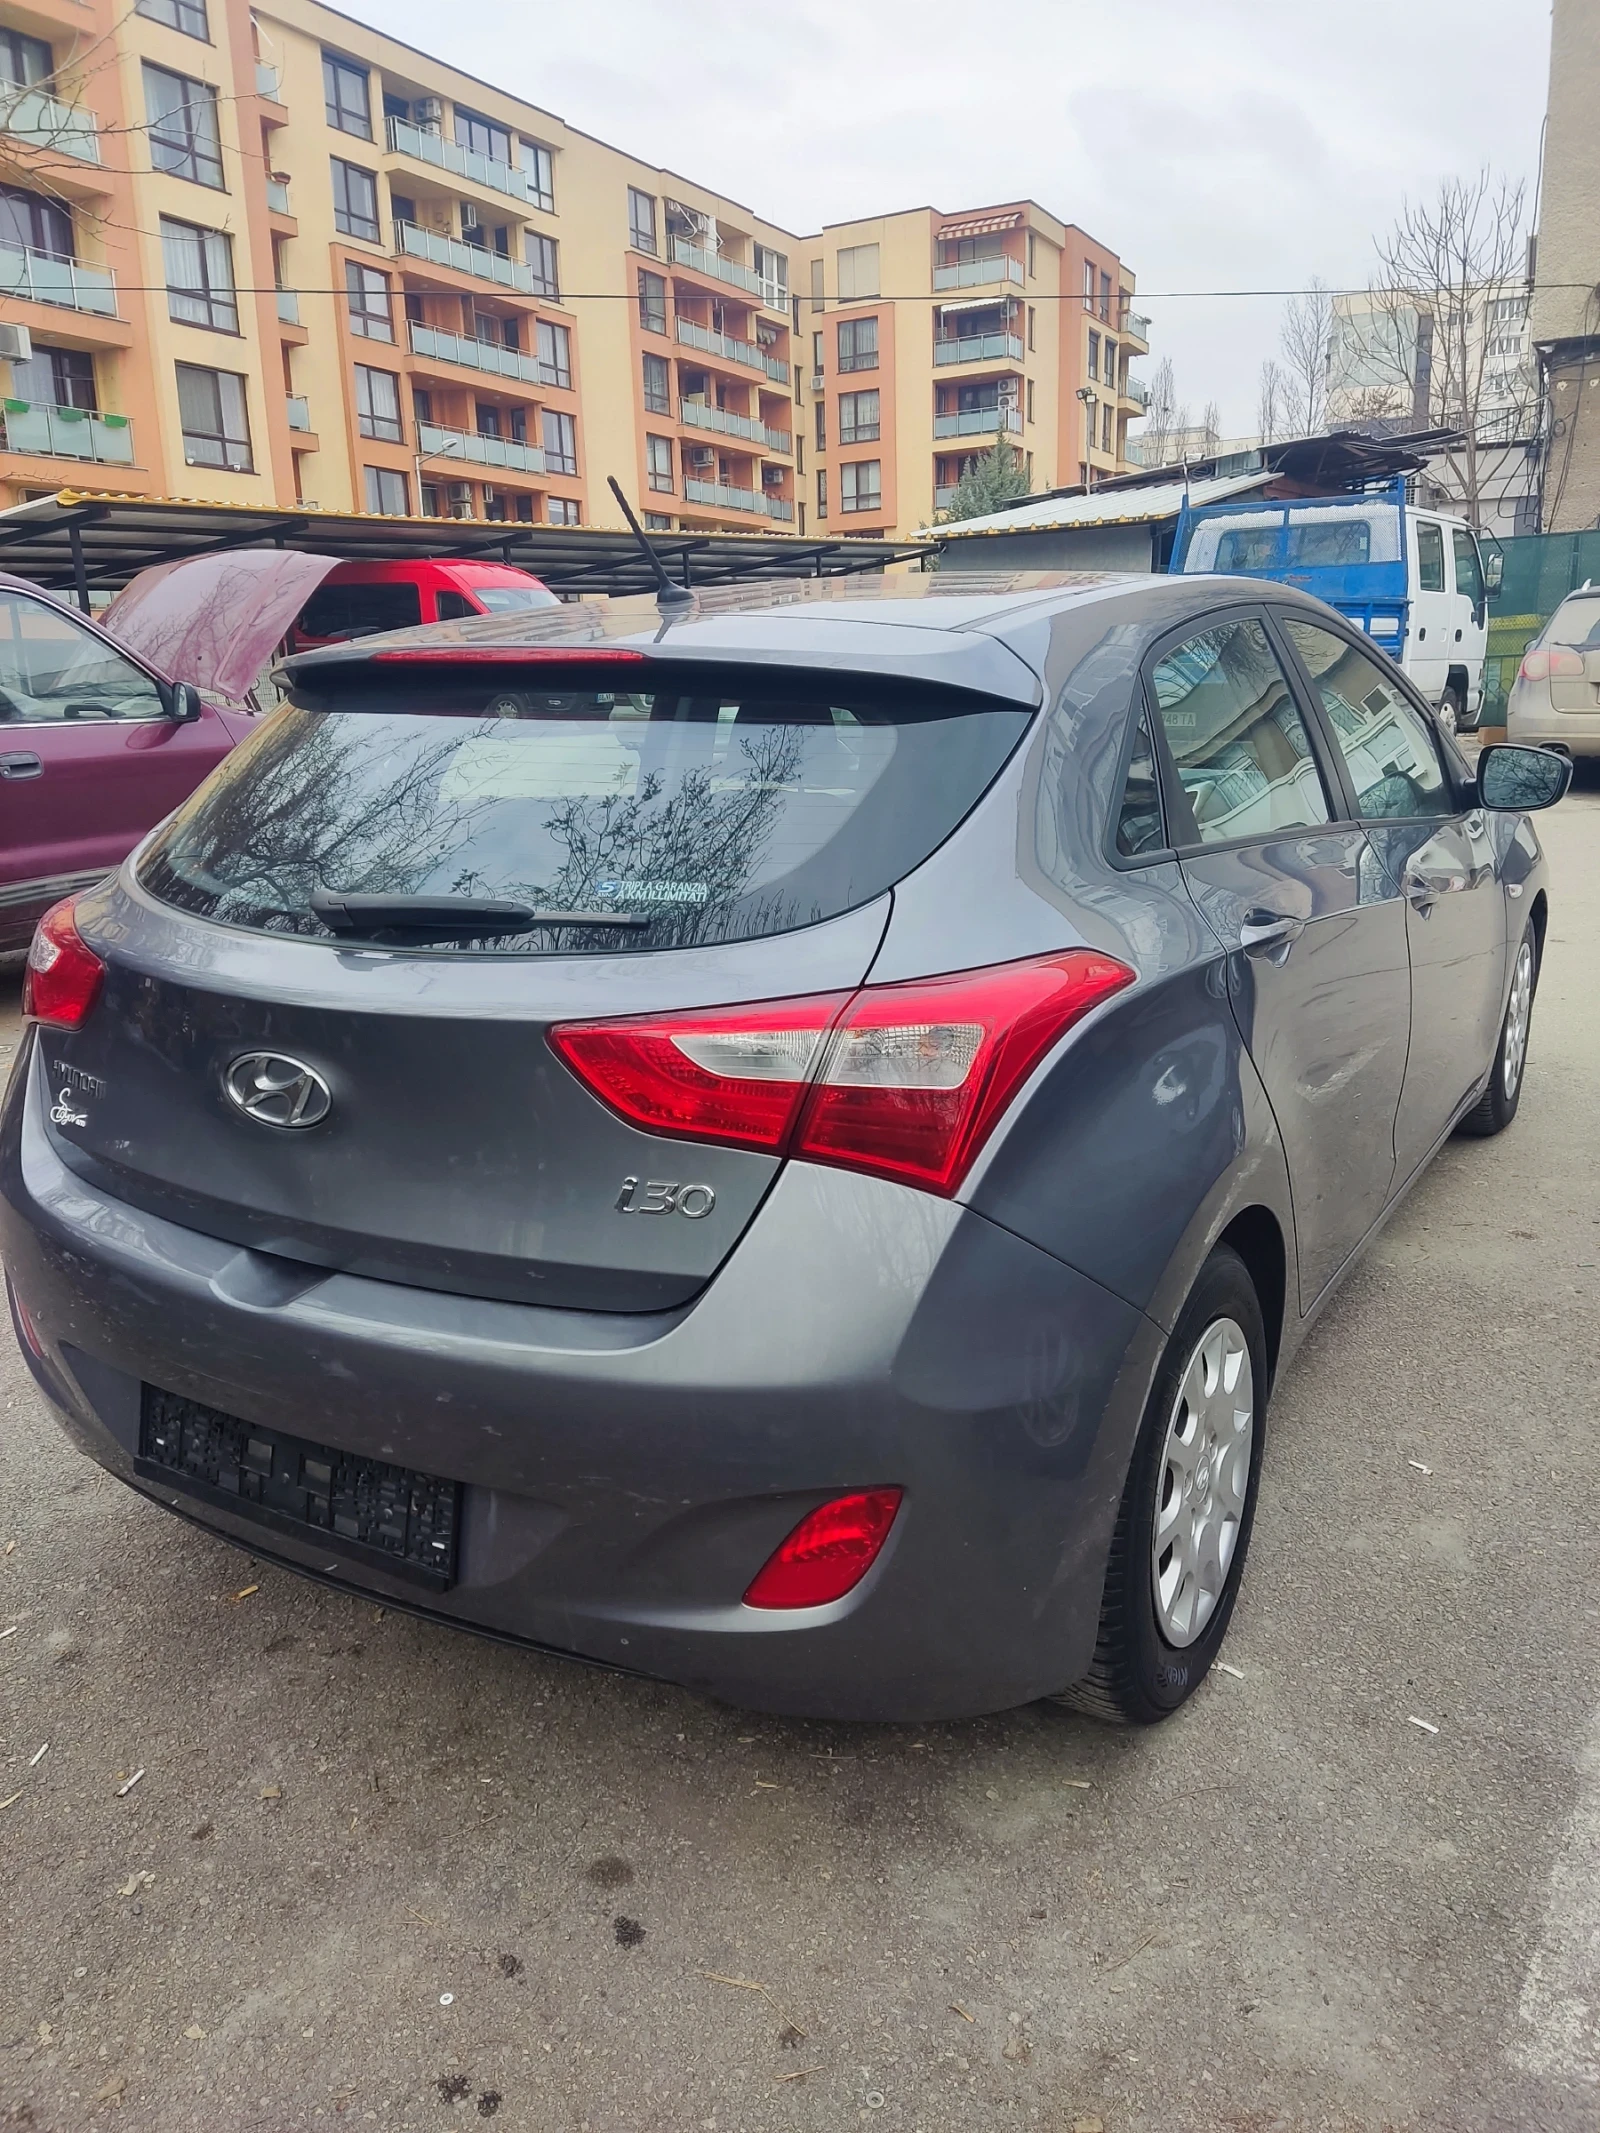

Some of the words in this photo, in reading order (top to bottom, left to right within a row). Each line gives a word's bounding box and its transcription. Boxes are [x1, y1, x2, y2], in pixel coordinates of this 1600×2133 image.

[1180, 713, 1194, 725] TA
[620, 880, 653, 892] TRIPLA
[655, 881, 708, 894] GARANZIA
[614, 890, 625, 900] A
[626, 889, 646, 901] KM
[646, 889, 708, 902] ILLIMITATI
[614, 1176, 716, 1219] i30
